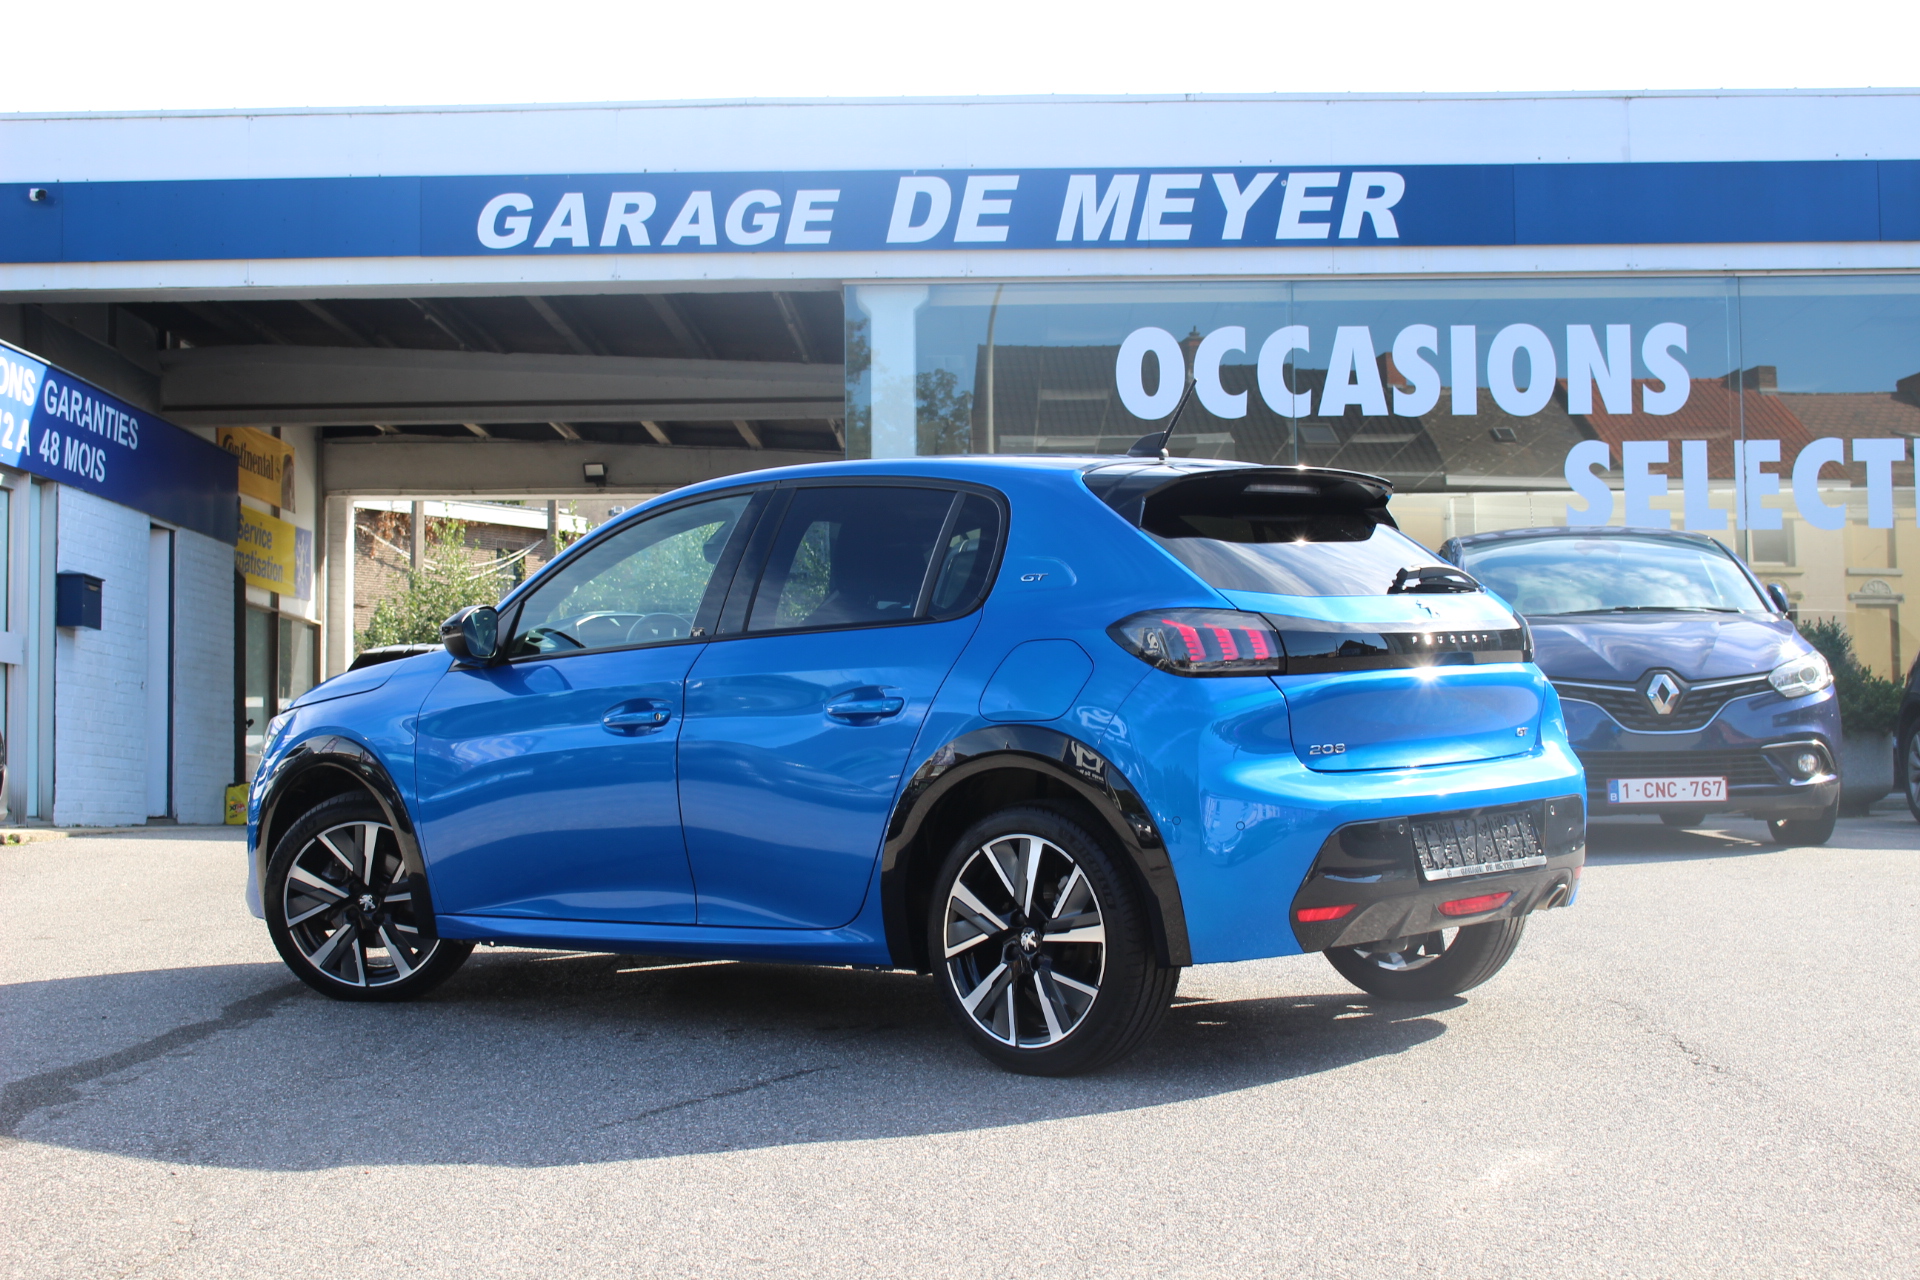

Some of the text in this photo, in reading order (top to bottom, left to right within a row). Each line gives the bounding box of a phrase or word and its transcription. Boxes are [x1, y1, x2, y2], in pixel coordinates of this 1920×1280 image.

[477, 172, 1406, 249] GARAGE DE MEYER
[1115, 323, 1691, 420] OCCASIONS
[44, 379, 139, 450] GARANTIES
[15, 418, 31, 456] A
[39, 428, 60, 466] 48
[63, 435, 106, 483] MOIS
[238, 514, 273, 550] Service
[1020, 573, 1049, 582] GT
[1309, 743, 1346, 755] 208
[1516, 727, 1528, 737] GT
[1610, 792, 1618, 801] B
